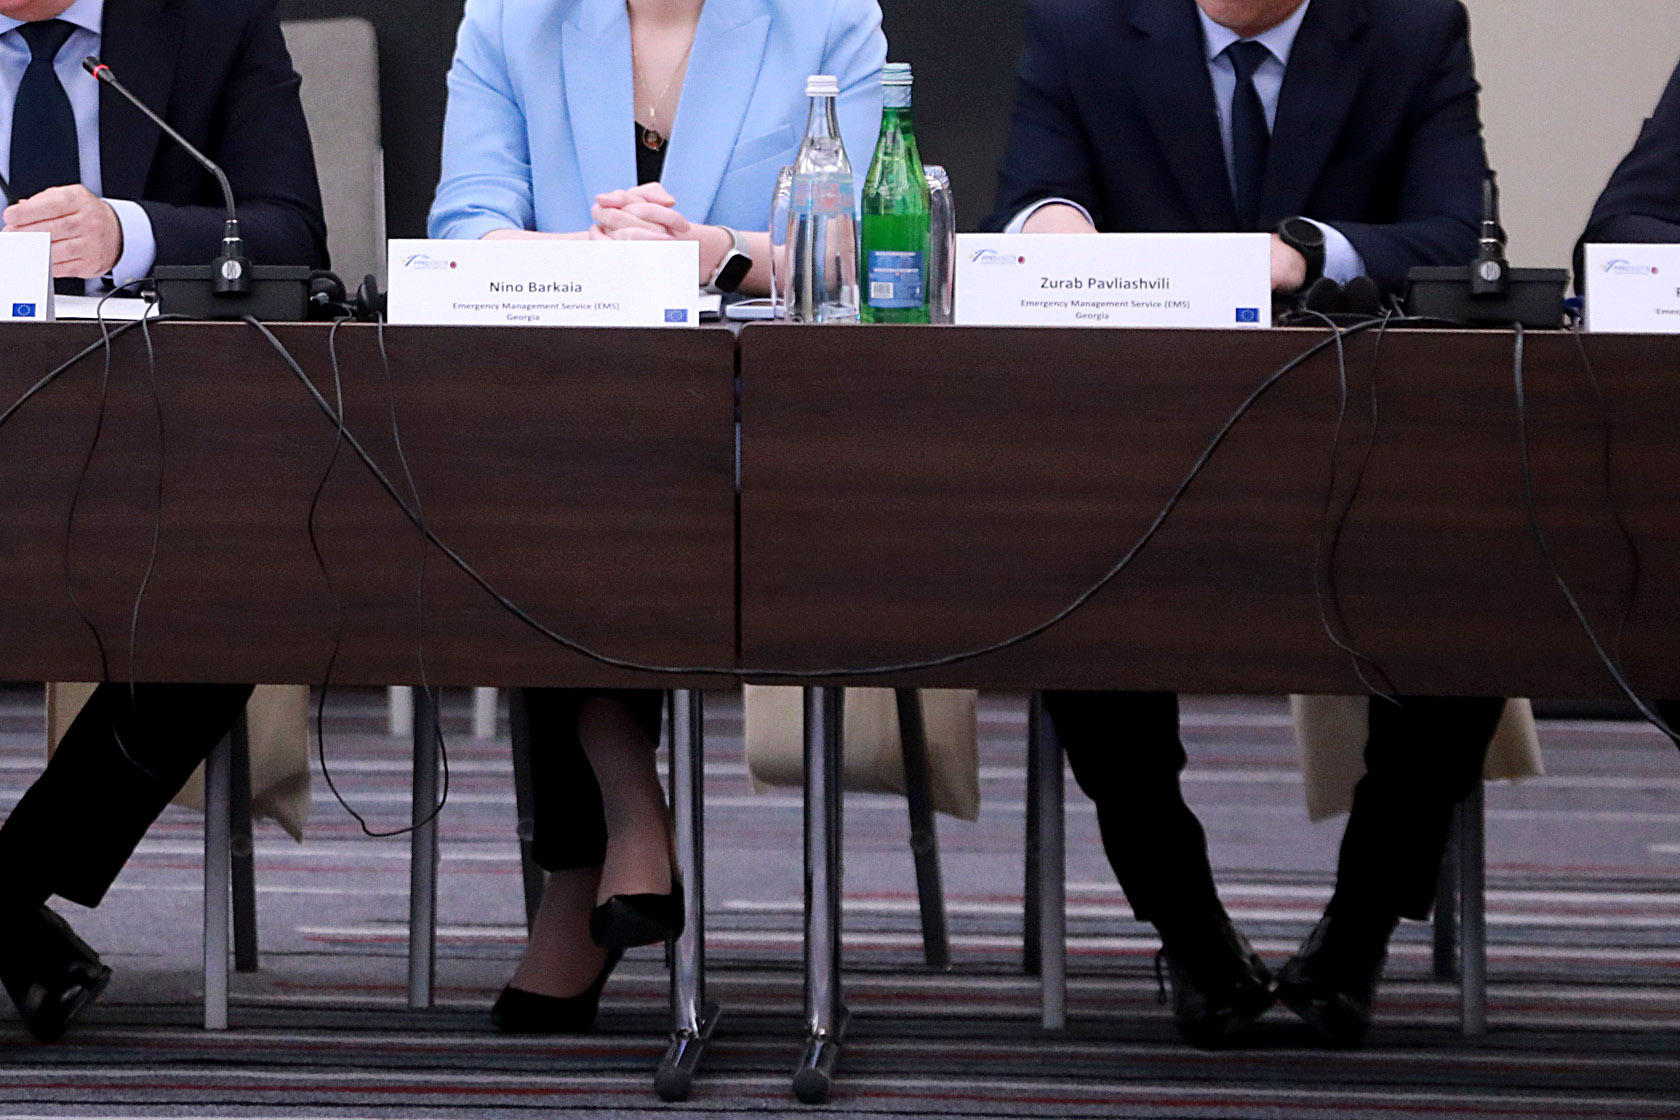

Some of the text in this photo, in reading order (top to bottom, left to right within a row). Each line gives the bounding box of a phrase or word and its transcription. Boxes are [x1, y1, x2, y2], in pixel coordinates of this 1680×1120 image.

[489, 281, 582, 293] Nino Barkaia
[1040, 276, 1170, 290] Zurab Pavliashvili
[452, 302, 620, 312] Emergency Management Service (EMS)
[1020, 299, 1190, 310] Emergency Management Service (EMS)
[506, 313, 541, 322] Georgia
[1074, 311, 1110, 321] Georgia
